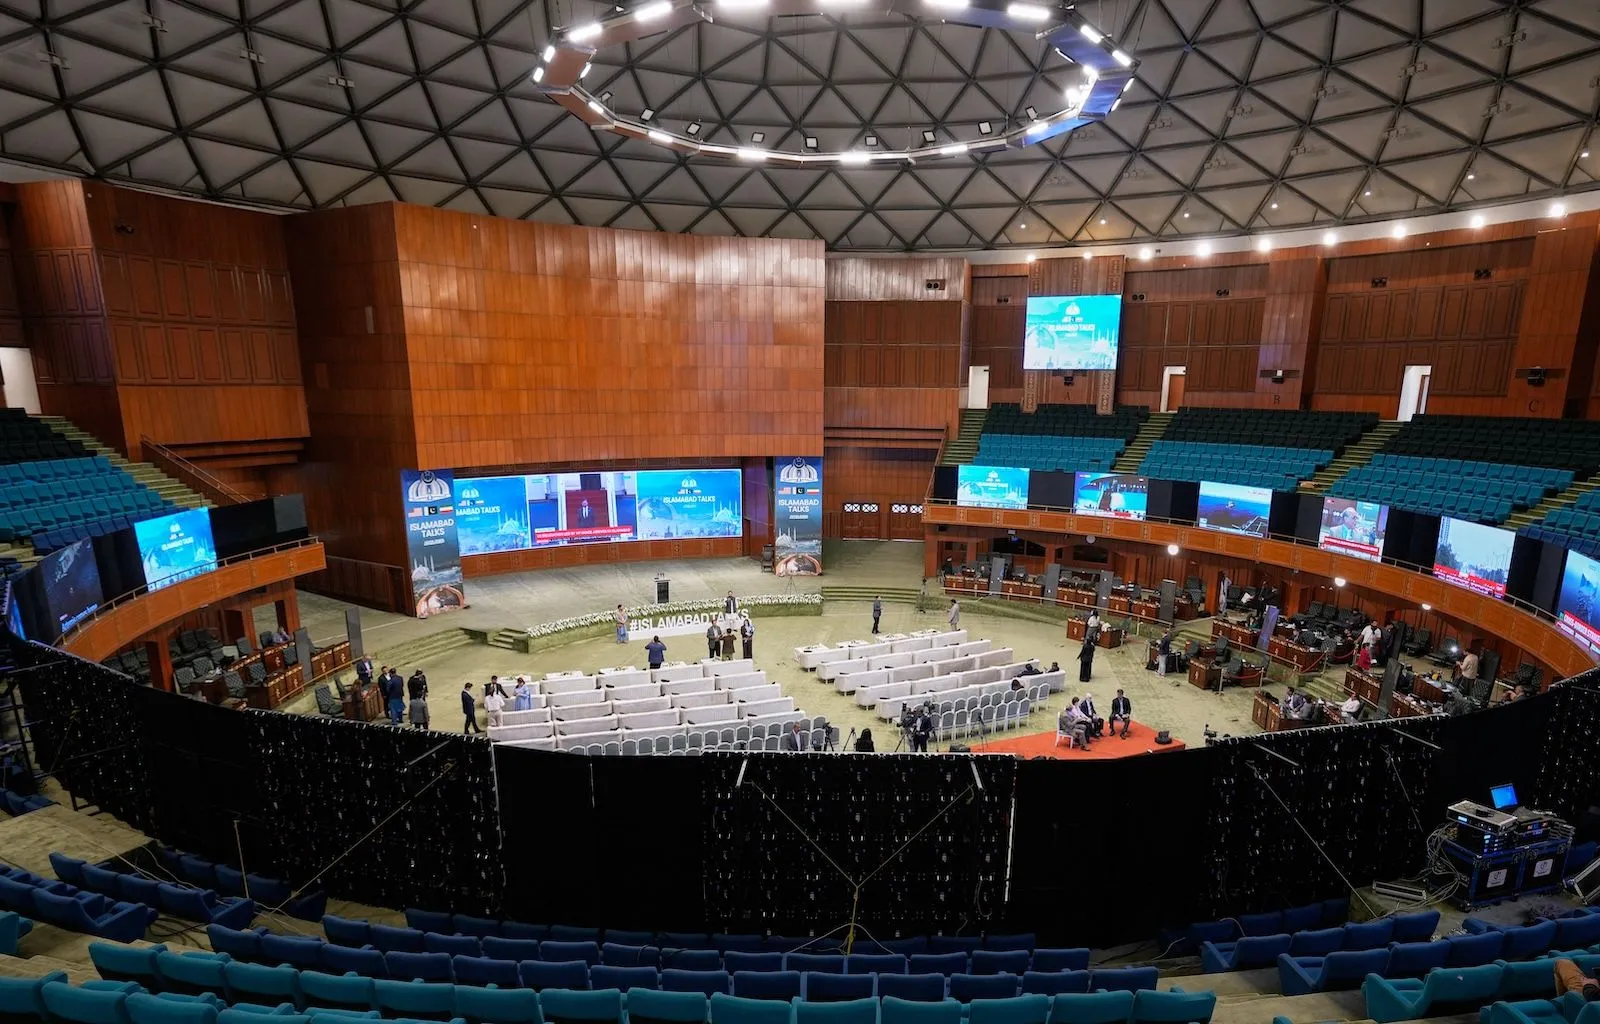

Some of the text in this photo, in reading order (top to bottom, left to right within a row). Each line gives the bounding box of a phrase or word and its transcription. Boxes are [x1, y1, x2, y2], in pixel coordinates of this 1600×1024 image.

[663, 495, 716, 504] ISLAMABAD TALKS
[481, 505, 501, 514] TALKS
[788, 505, 810, 513] TALKS
[409, 518, 454, 531] ISLAMABAD
[421, 527, 445, 538] TALKS
[629, 608, 749, 632] #ISLAMABADTAKS
